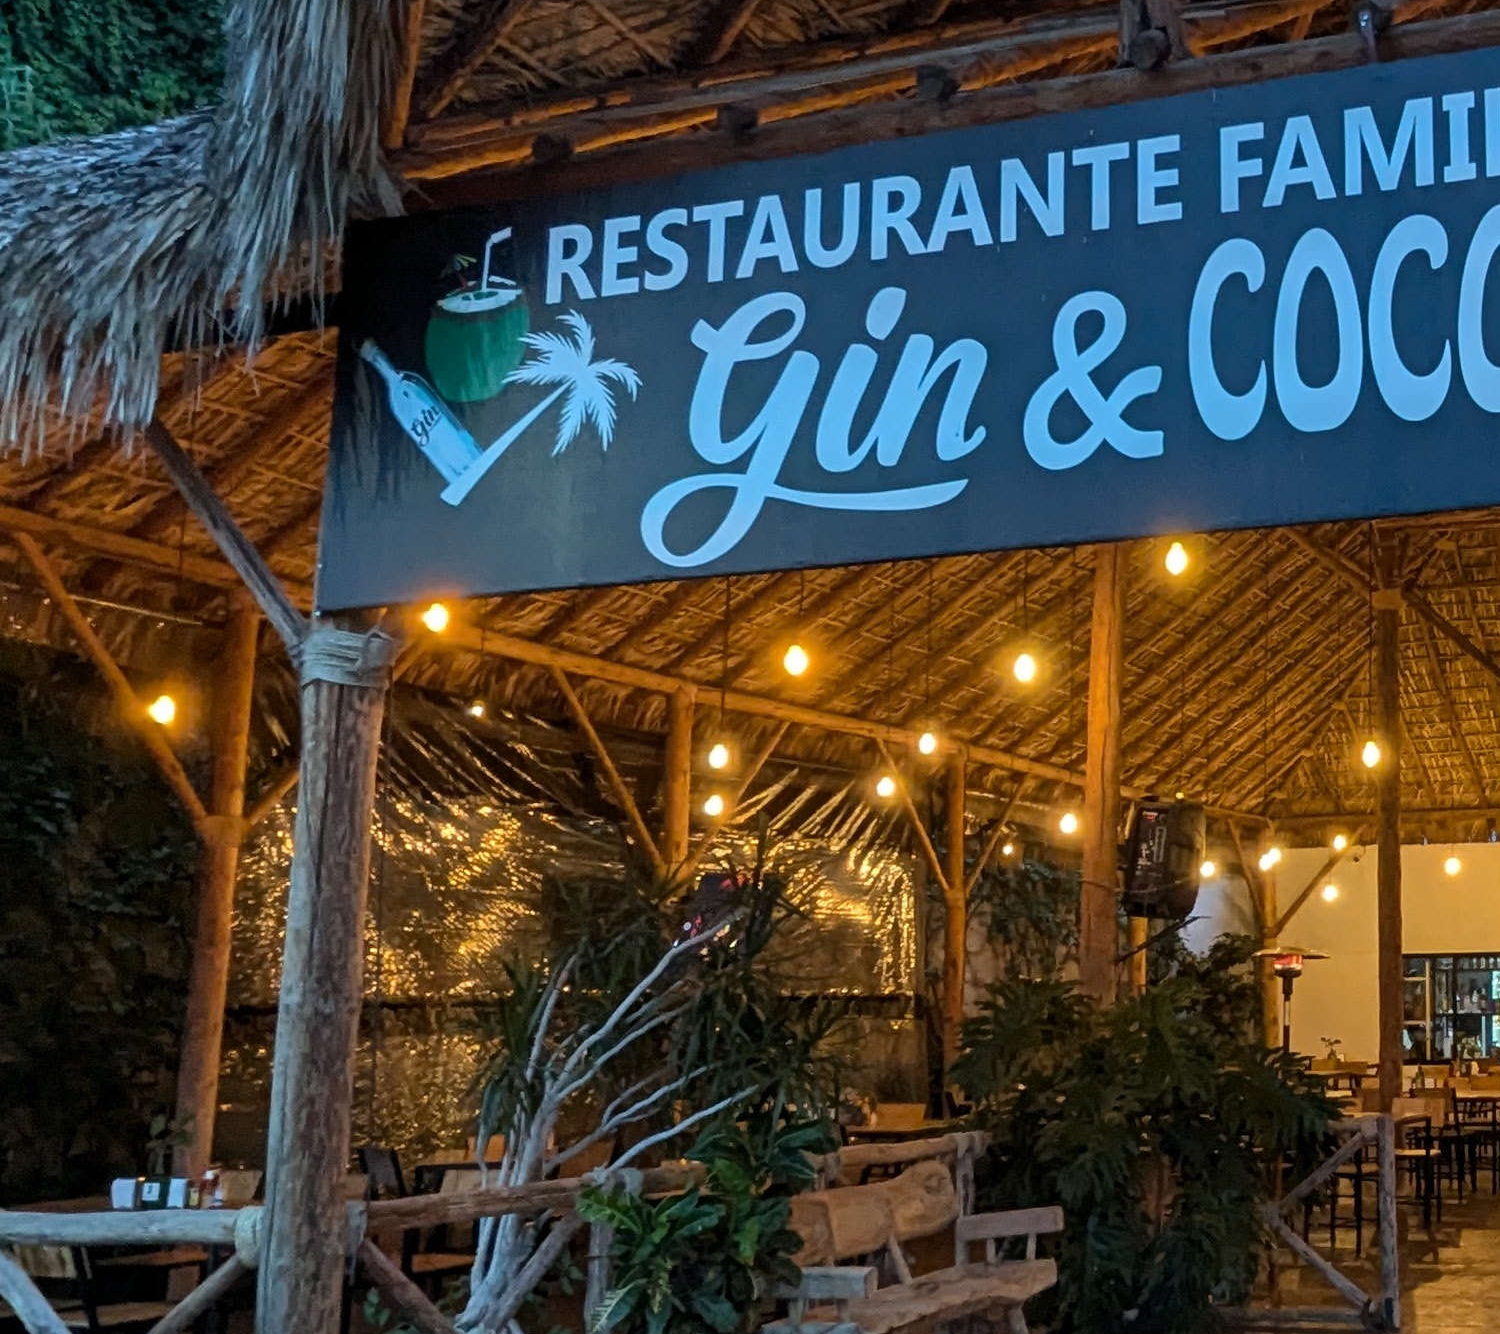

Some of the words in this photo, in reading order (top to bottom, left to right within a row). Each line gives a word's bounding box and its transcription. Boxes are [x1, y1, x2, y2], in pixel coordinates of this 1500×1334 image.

[545, 134, 1183, 306] RESTAURANTE
[410, 405, 442, 447] Gin
[640, 286, 988, 568] Gin
[1023, 290, 1164, 471] &
